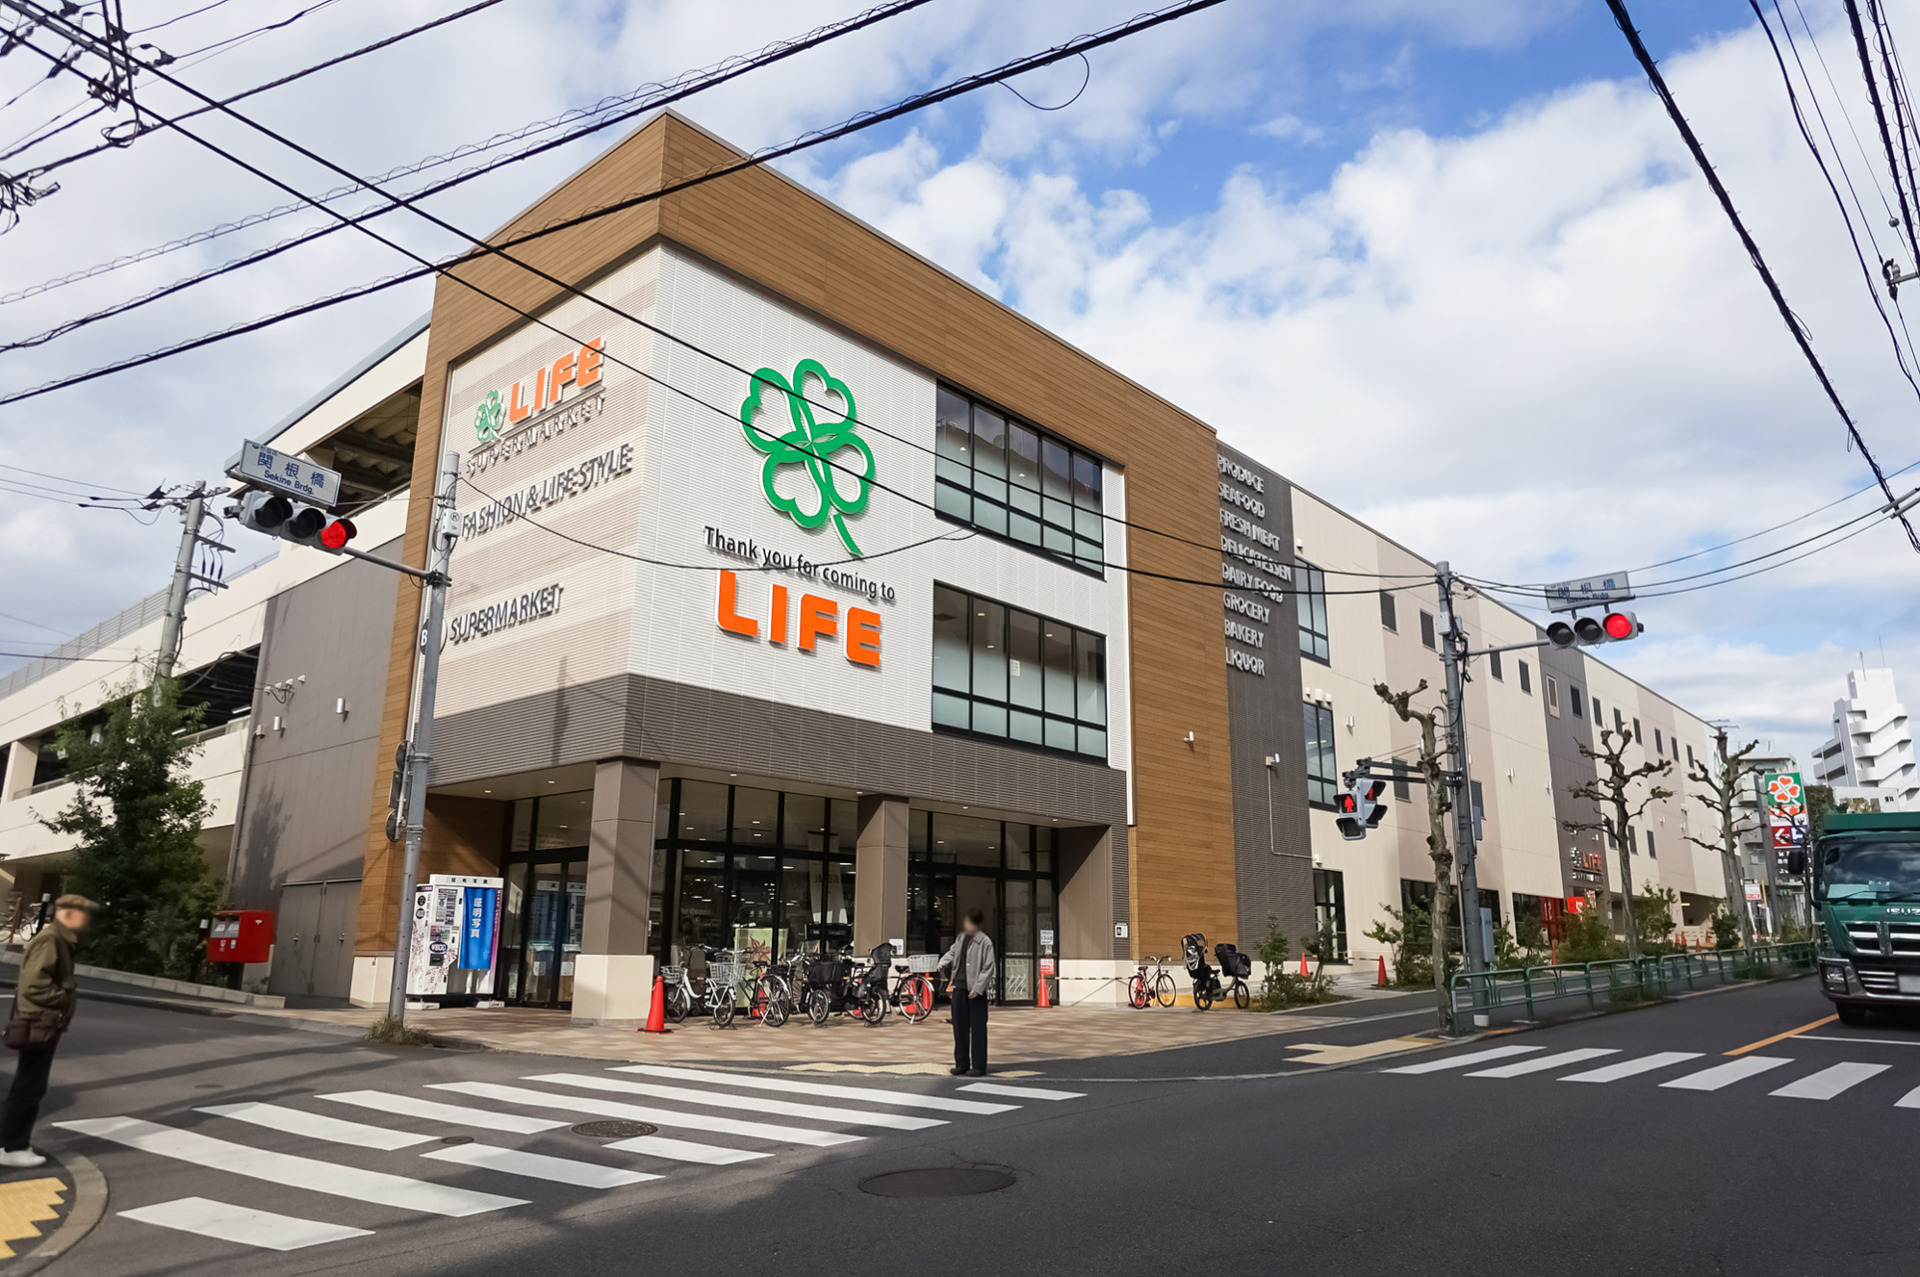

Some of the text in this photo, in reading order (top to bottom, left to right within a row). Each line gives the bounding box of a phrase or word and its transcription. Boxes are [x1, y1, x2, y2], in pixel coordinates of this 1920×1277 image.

[509, 336, 604, 422] LIFE
[467, 393, 605, 476] SUPERMARKET
[257, 451, 325, 489] 関根橋
[264, 469, 292, 487] Sekine
[1217, 453, 1265, 494] PRODUCE
[461, 490, 526, 538] FASHION
[1218, 481, 1266, 519] SEAFOOD
[1219, 508, 1281, 552] FRESH MEAT
[704, 525, 895, 600] Thank you for coming to
[1220, 534, 1293, 582] DELICATESSEN
[1222, 562, 1285, 604] DAIRY FOOD
[450, 582, 562, 643] SUPERMARKET
[717, 569, 881, 667] LIFE
[1223, 592, 1271, 625] GROCERY
[1224, 617, 1265, 649] BAKERY
[1225, 647, 1265, 677] LIQUOR
[470, 897, 483, 938] 証明写真
